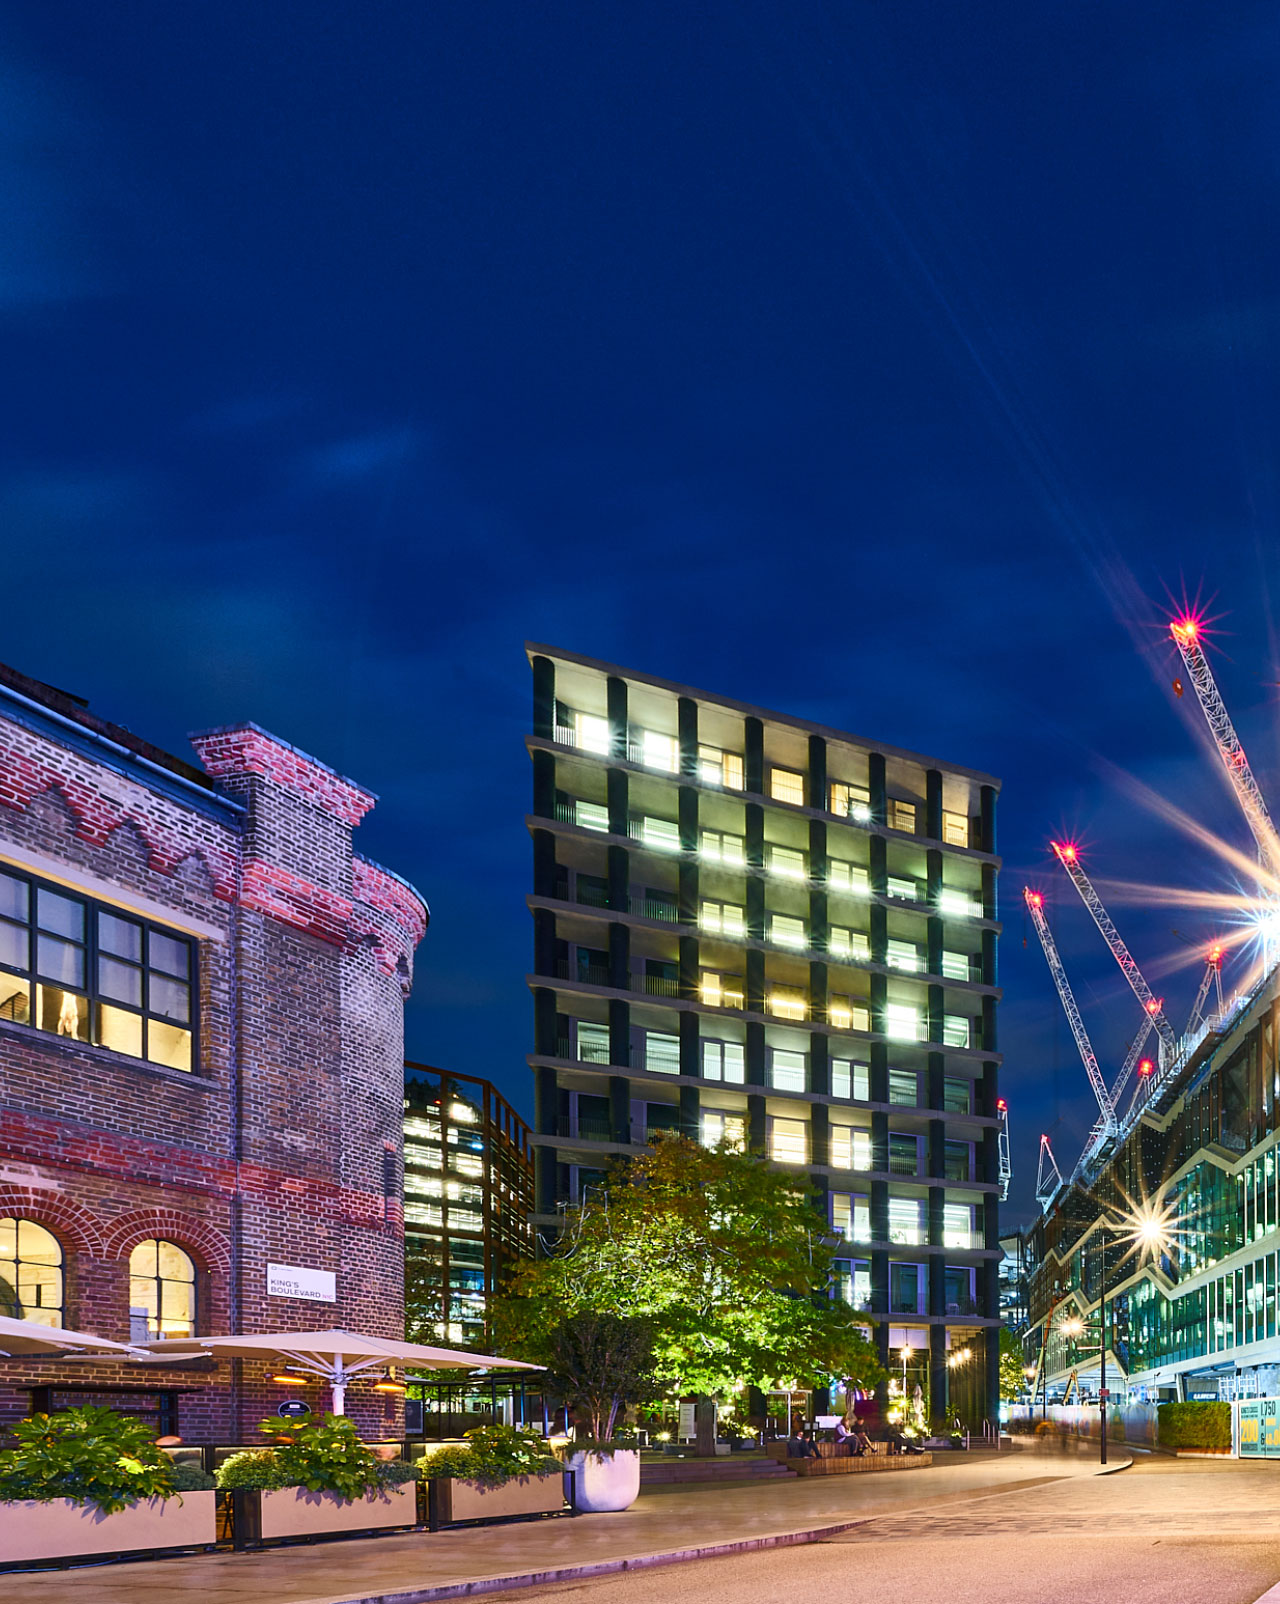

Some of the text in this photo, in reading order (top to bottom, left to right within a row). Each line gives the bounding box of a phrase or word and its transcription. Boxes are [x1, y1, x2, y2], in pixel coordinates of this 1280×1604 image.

[270, 1279, 299, 1288] KING'S
[270, 1286, 321, 1298] BOULEVARD
[1240, 1419, 1259, 1442] 200
